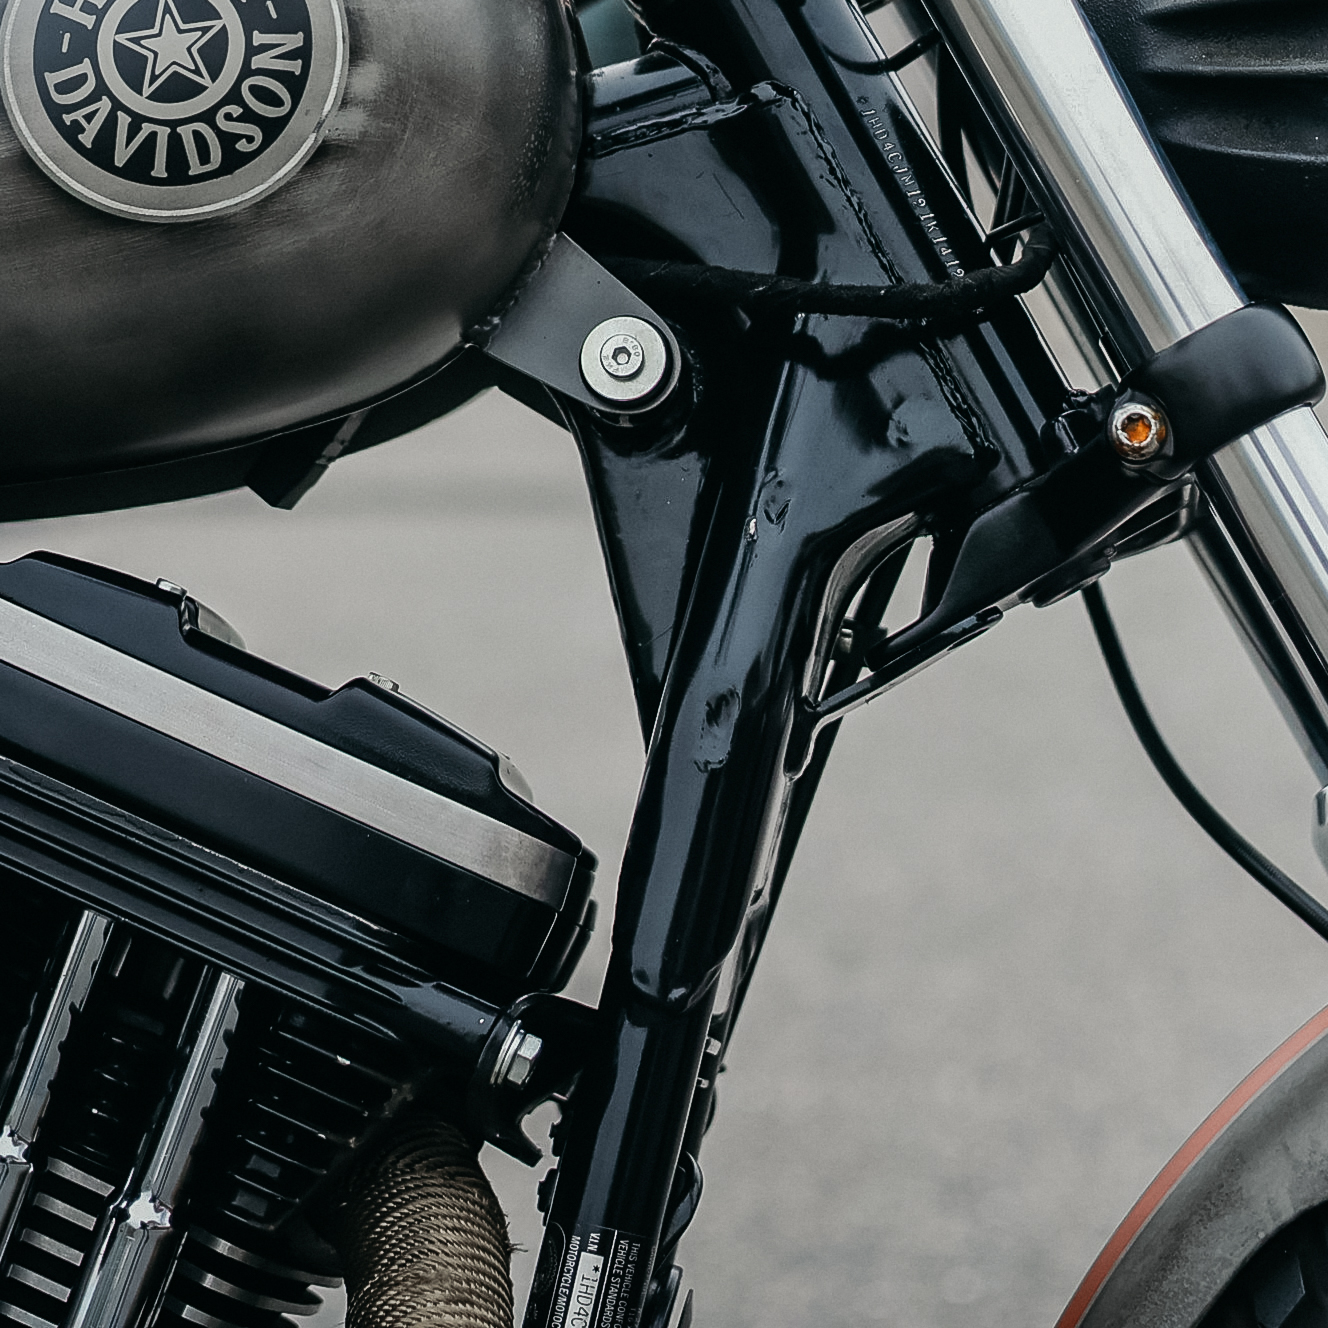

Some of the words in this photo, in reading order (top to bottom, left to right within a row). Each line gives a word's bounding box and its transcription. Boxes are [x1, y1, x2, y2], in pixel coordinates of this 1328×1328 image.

[43, 30, 304, 178] DAVIDSON
[612, 1239, 630, 1276] VEHICLE
[629, 1242, 641, 1262] THIS
[620, 1263, 635, 1299] VEHICLE
[601, 1276, 621, 1328] STANDARDS
